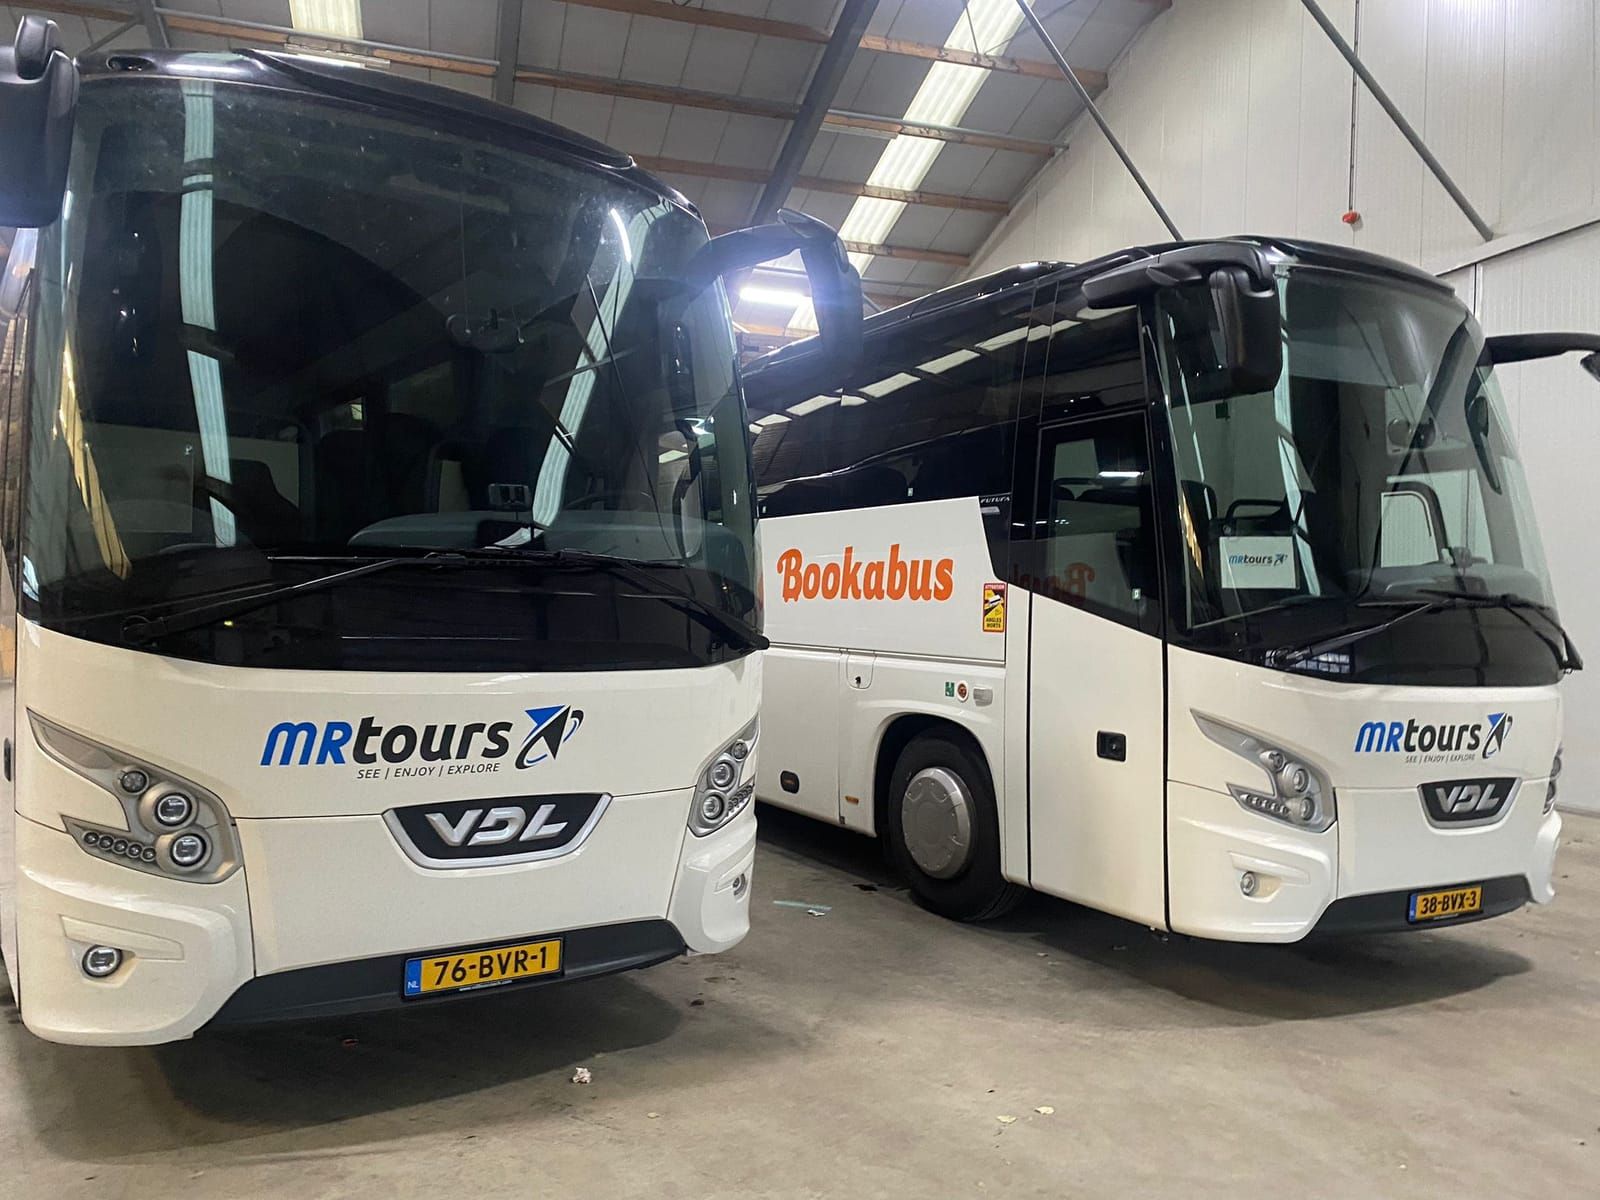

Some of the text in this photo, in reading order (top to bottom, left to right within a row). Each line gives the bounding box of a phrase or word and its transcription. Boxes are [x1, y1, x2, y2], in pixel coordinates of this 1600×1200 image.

[776, 543, 954, 603] Bookabus
[260, 716, 514, 766] MRtours
[1354, 718, 1482, 753] MRtours
[357, 769, 381, 780] SEE
[394, 766, 436, 778] ENJOY
[447, 762, 501, 775] EXPLORE
[1435, 783, 1500, 814] VDL
[425, 804, 569, 847] VDL
[1421, 890, 1477, 915] 38-BVX-3
[407, 981, 419, 989] NL
[434, 946, 547, 986] 76-BVR-1
